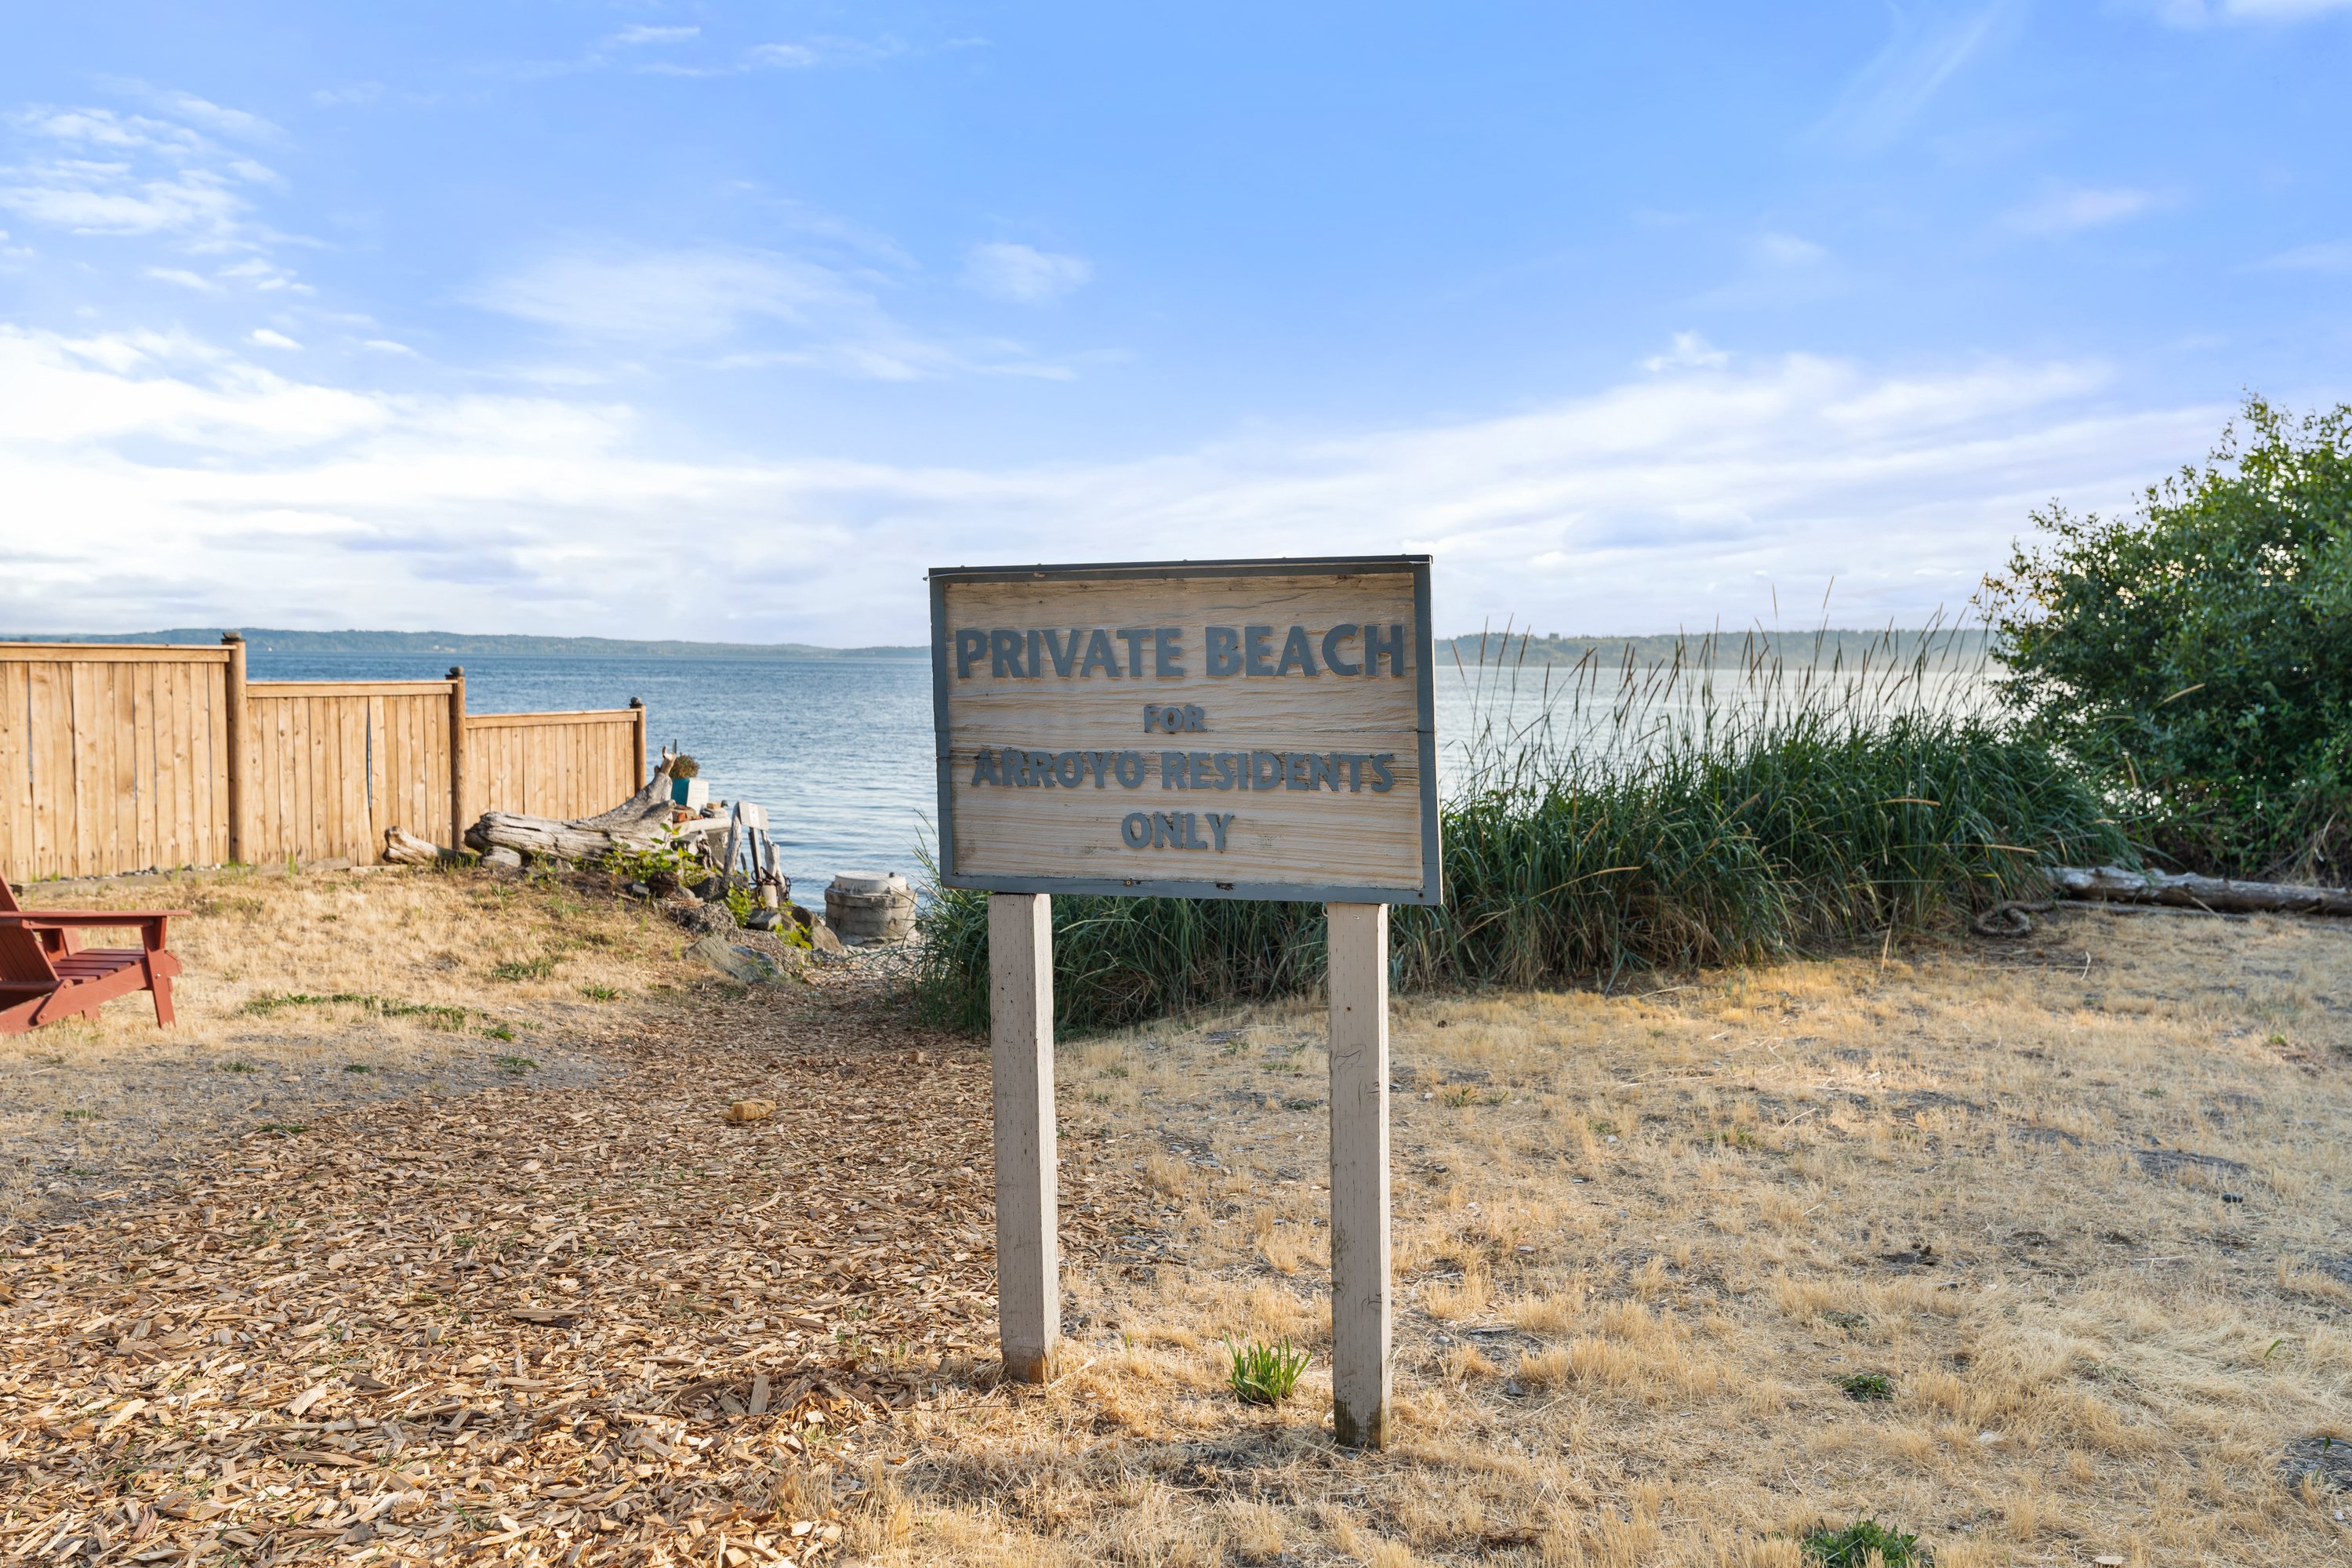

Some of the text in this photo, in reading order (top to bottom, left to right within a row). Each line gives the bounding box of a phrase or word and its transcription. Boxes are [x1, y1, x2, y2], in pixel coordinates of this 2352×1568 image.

[956, 624, 1405, 678] PRIVATE BEACH
[1144, 706, 1205, 732] FOR
[971, 749, 1394, 793] ARROYO RESIDENTS
[1120, 813, 1234, 851] ONLY
